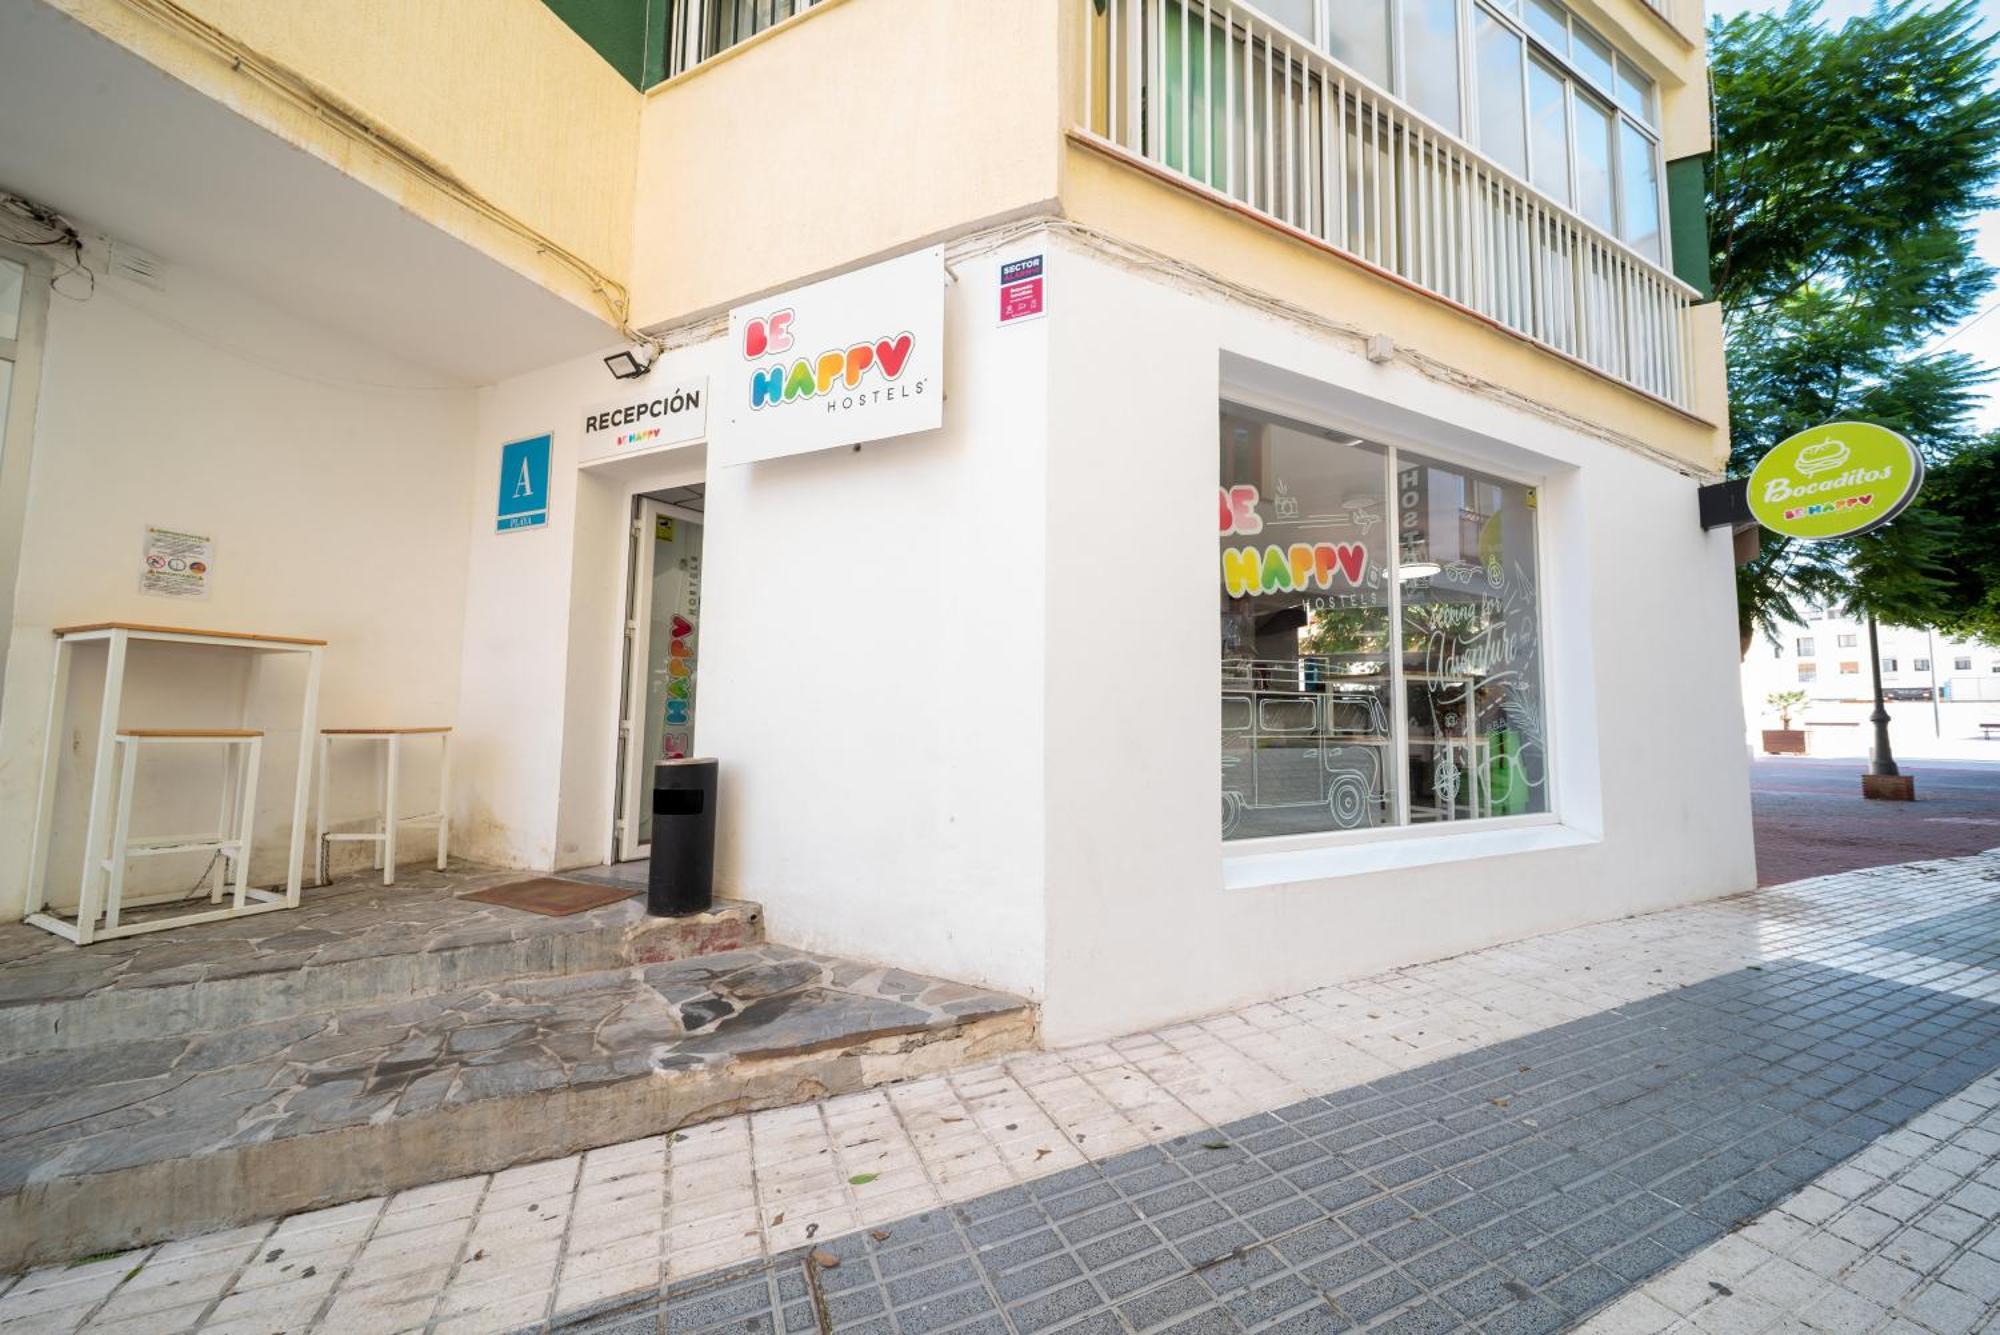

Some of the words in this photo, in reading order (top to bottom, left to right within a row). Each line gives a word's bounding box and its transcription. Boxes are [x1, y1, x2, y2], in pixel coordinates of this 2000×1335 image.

[1003, 258, 1040, 274] SECTOR
[744, 308, 795, 361] BE
[586, 388, 700, 434] RECEPCIÓN
[827, 382, 925, 413] HOSTELS
[512, 456, 534, 498] A
[1764, 465, 1892, 503] Bocaditos
[1302, 592, 1377, 611] HOSTELS
